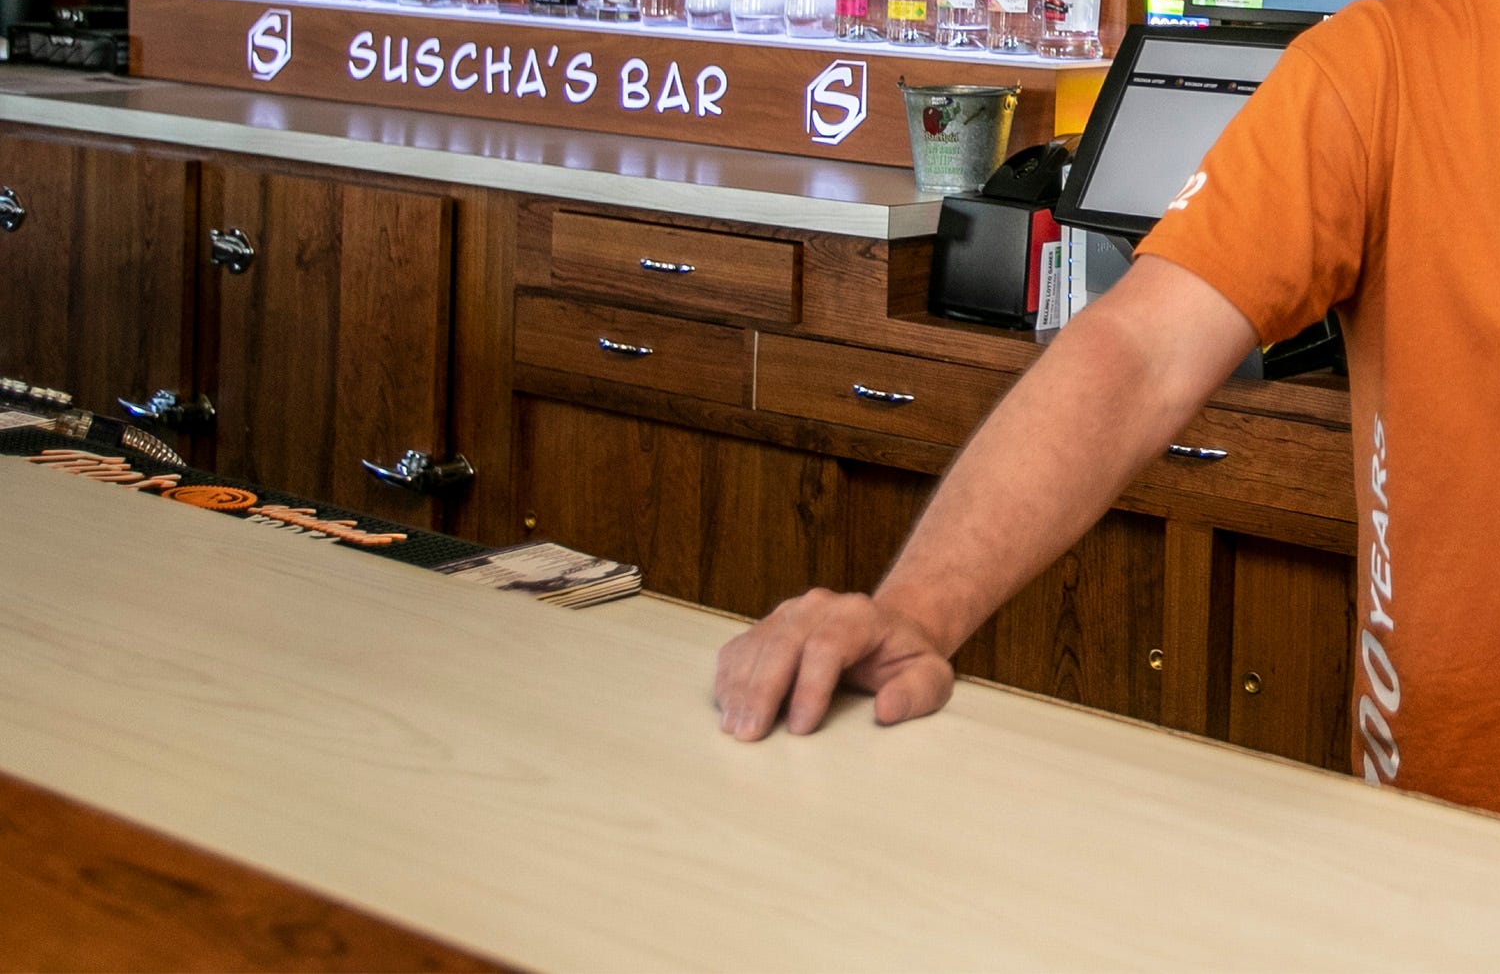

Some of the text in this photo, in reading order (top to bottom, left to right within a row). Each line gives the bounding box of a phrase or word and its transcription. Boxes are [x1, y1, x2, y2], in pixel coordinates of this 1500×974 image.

[347, 31, 730, 117] SUSCHA'S BAR
[1369, 410, 1395, 632] YEARS
